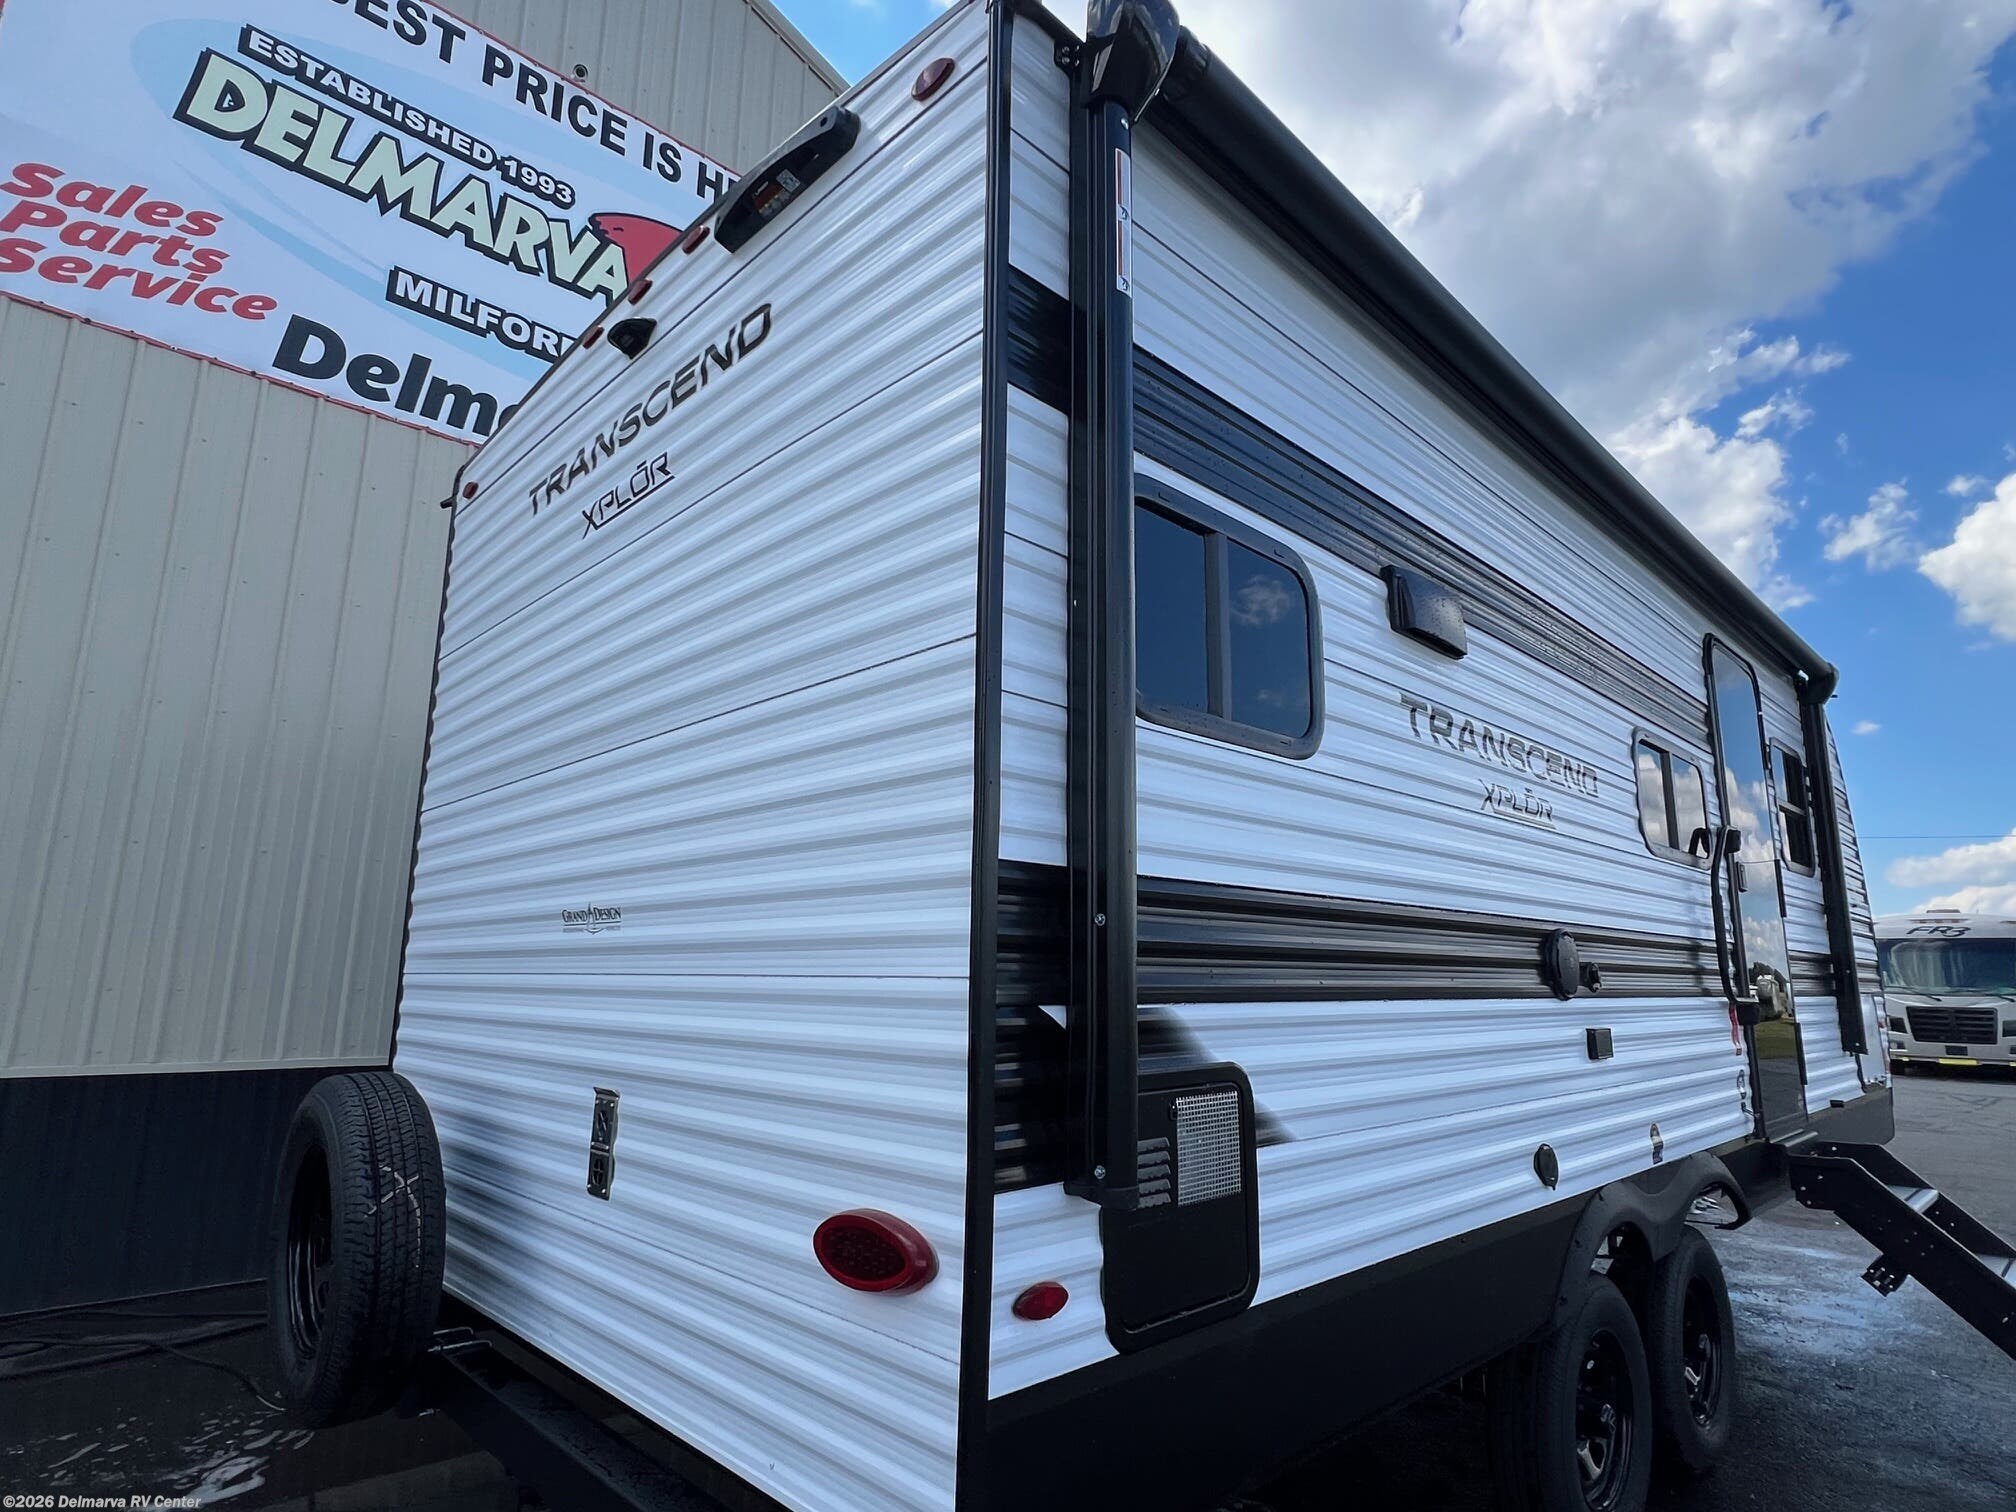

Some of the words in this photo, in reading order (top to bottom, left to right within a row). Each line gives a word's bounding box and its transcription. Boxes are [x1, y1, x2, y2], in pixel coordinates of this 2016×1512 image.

[248, 29, 494, 164] ESTABLISHED
[504, 159, 573, 204] 1993
[330, 0, 466, 64] EST
[481, 43, 628, 156] PRICE
[642, 131, 682, 183] IS
[696, 161, 737, 204] H
[0, 200, 230, 274] Parts
[1, 163, 224, 237] Sales
[178, 50, 628, 305] DELMARVA
[0, 238, 278, 319] Service
[529, 303, 772, 516] TRANSCEND
[1400, 692, 1599, 798] TRANSCEND
